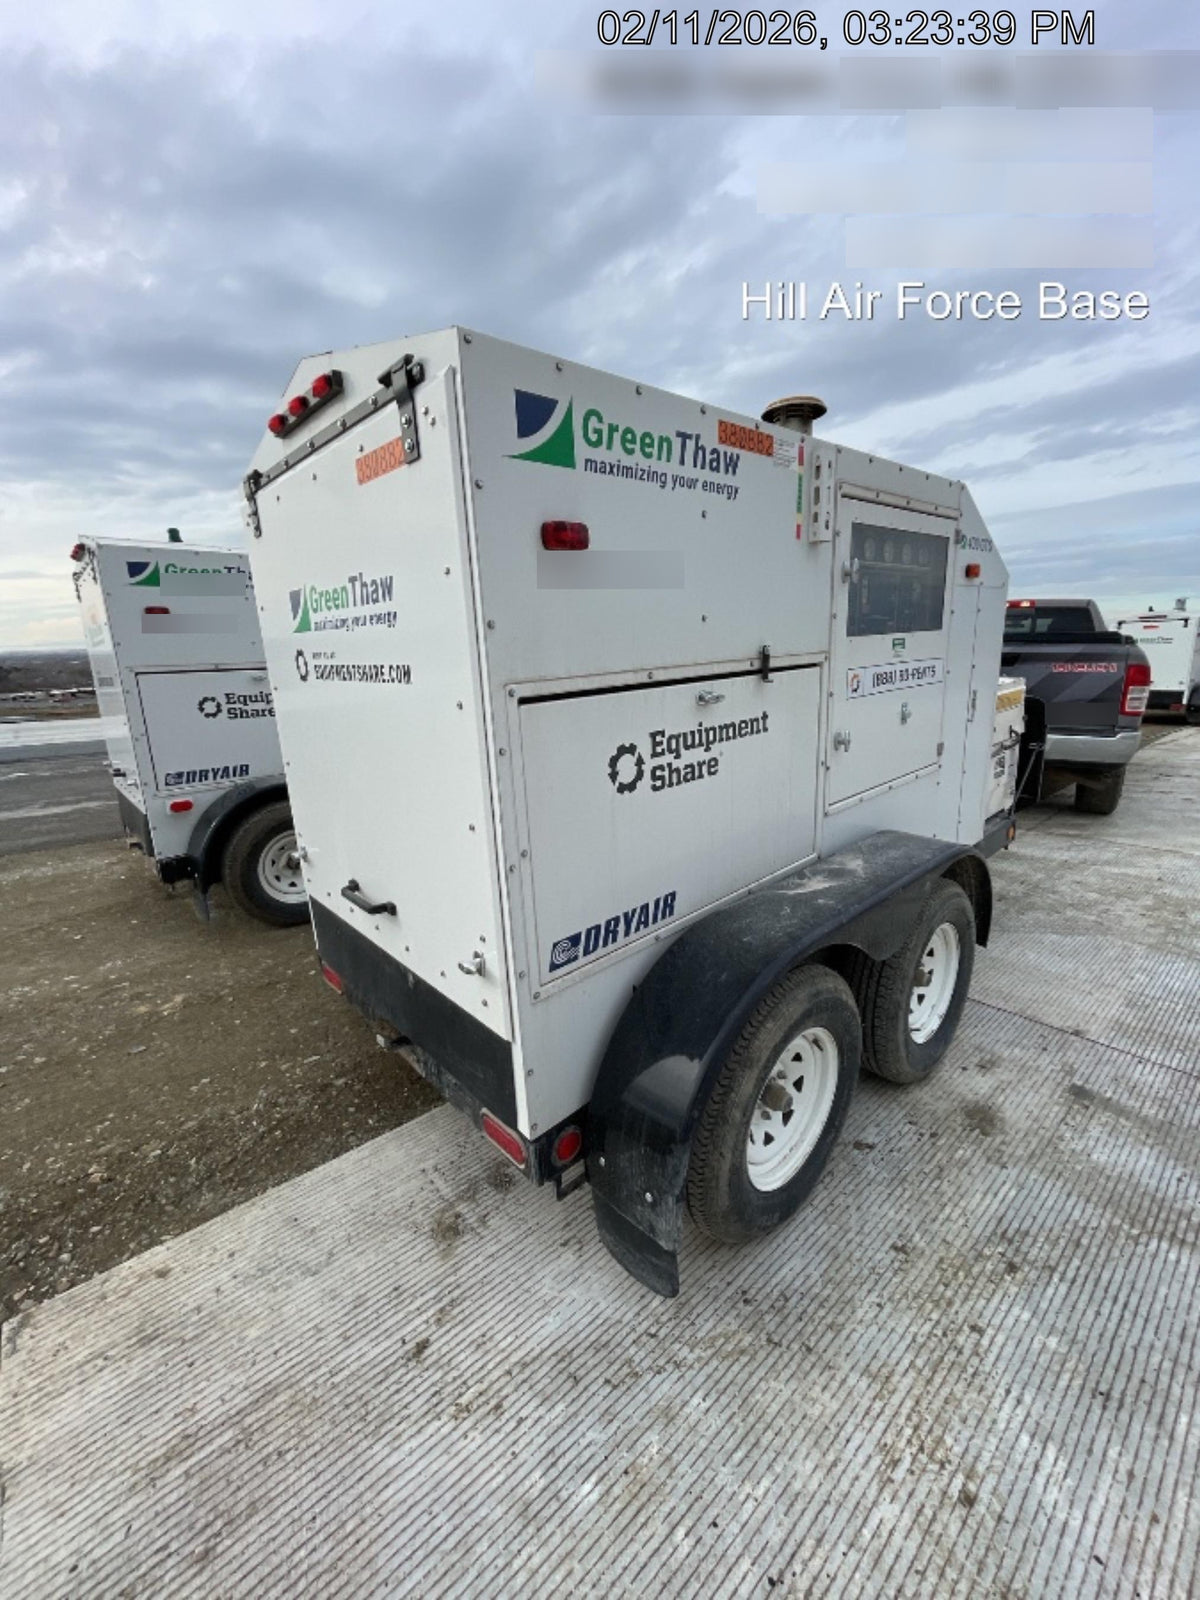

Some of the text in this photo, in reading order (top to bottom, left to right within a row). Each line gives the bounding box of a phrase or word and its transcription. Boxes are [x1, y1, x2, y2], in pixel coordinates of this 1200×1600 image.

[584, 457, 740, 501] maximizing your energy
[224, 691, 273, 706] Equip
[226, 706, 276, 720] Share
[648, 710, 769, 760] Equipment
[185, 764, 250, 783] DRYAIR
[650, 755, 719, 793] Share
[582, 890, 677, 957] DRYAIR
